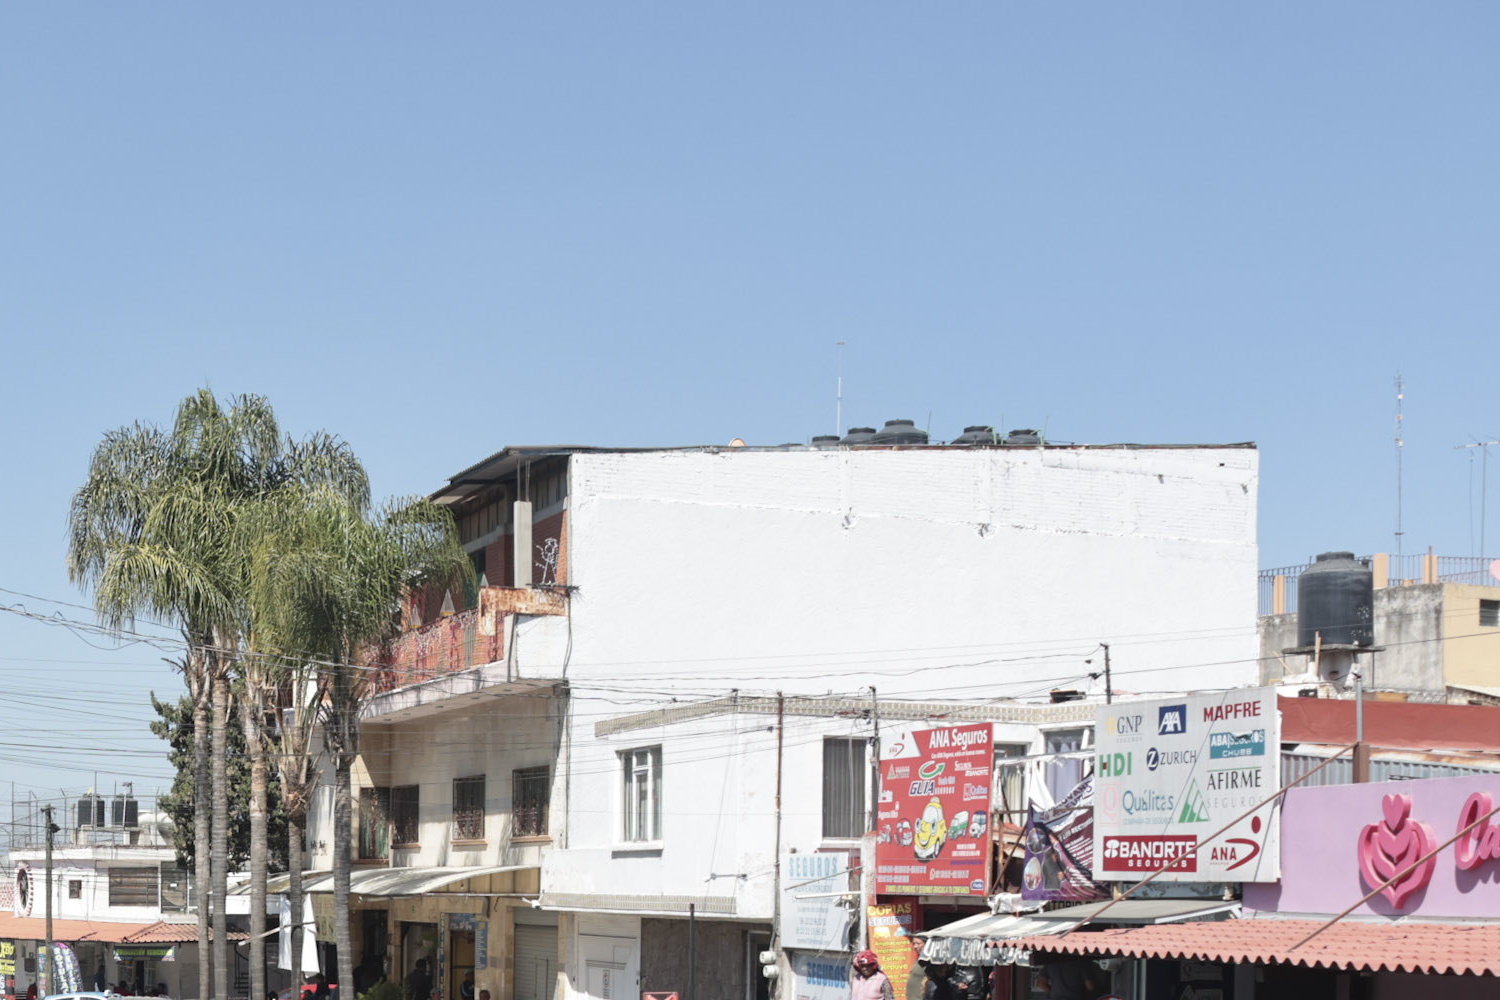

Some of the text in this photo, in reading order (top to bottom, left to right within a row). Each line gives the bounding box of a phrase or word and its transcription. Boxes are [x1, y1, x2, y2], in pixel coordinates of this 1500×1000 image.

[1203, 701, 1261, 722] MAPFRE
[1117, 715, 1142, 735] GNP
[1158, 710, 1182, 736] AXA
[929, 728, 988, 751] ANA Seguros
[1099, 751, 1132, 778] HDI
[1160, 749, 1198, 765] ZURICH
[1207, 769, 1262, 790] AFIRME
[1122, 787, 1174, 815] Quálitas
[1207, 795, 1263, 809] SEGUROS
[1119, 841, 1196, 859] BANORTE
[1210, 847, 1238, 862] ANA
[789, 857, 838, 877] SEGUROS
[1128, 859, 1188, 868] SEGUROS
[867, 903, 912, 916] COPIAS
[869, 914, 912, 926] SEGUROS
[806, 962, 846, 989] SEGUROS
